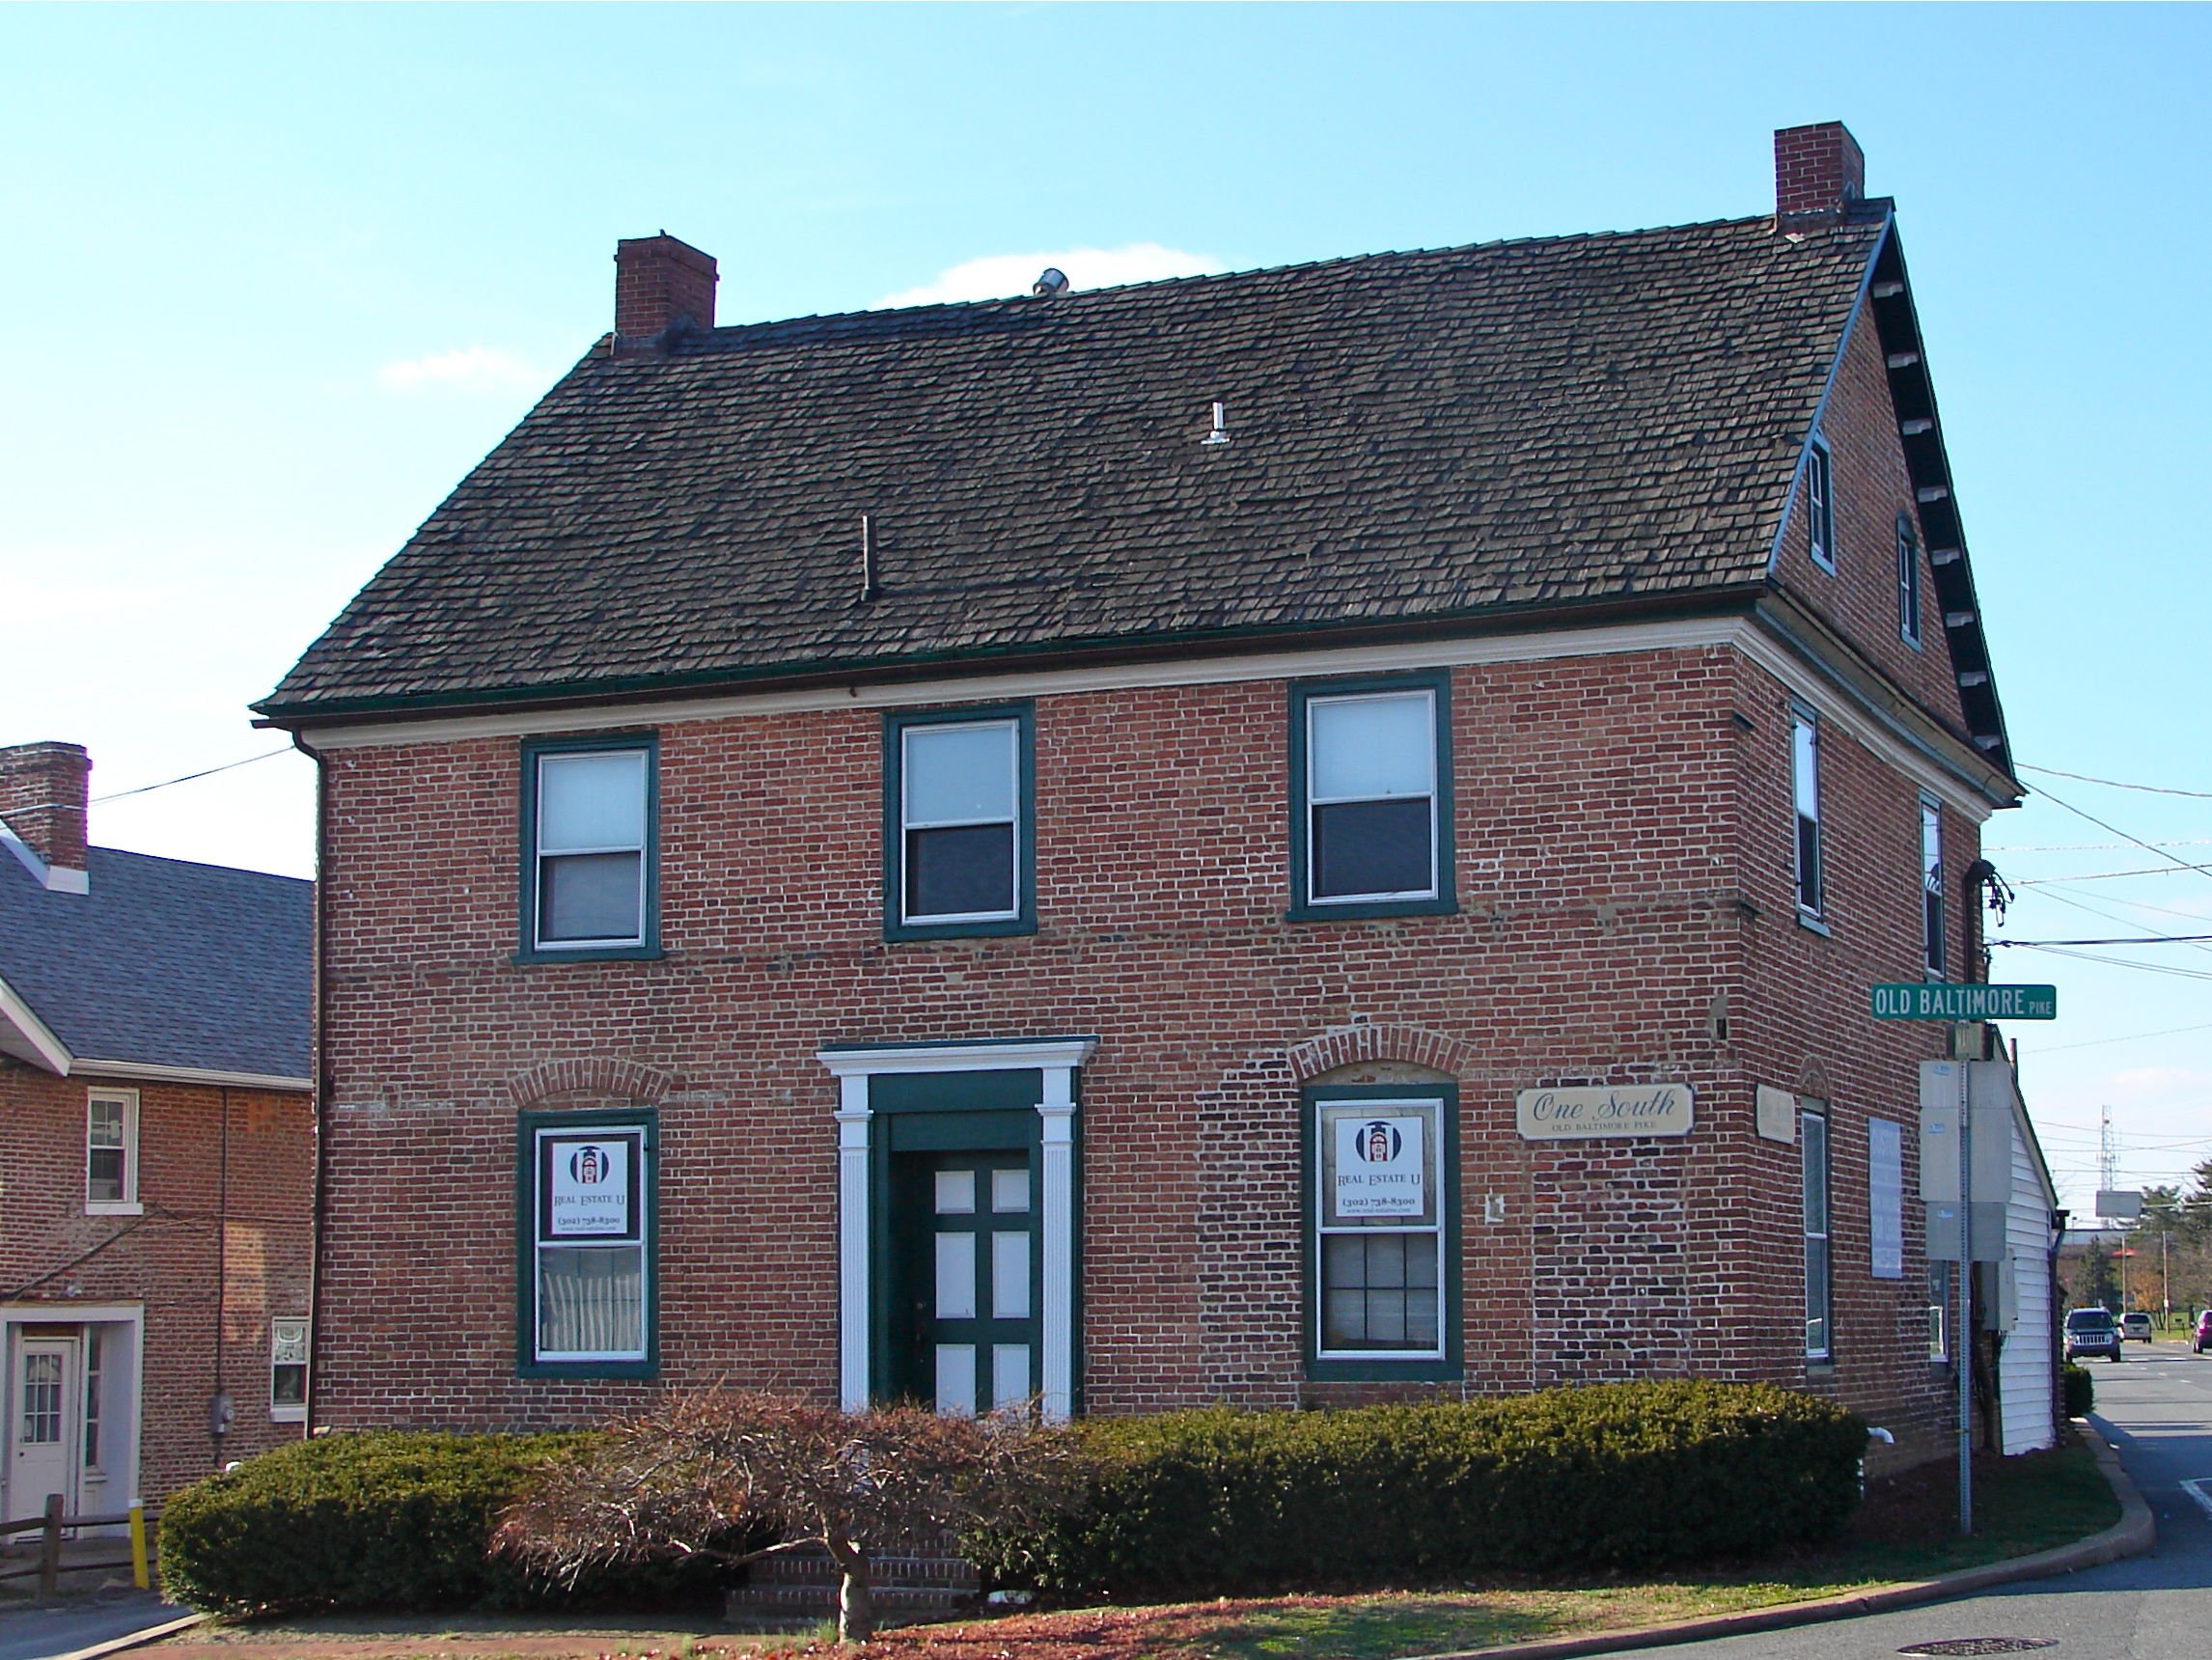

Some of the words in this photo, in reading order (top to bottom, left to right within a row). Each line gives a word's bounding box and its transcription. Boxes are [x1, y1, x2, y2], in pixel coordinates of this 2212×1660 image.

[1875, 988, 1911, 1014] OLD
[1920, 988, 2025, 1014] BALTIMORE
[2029, 1001, 2053, 1014] PIKE
[1533, 1093, 1584, 1121] One
[1591, 1088, 1675, 1121] South
[1551, 1123, 1571, 1132] OLD
[1576, 1121, 1629, 1131] BALTIMORE
[1338, 1175, 1364, 1186] REAL
[1369, 1174, 1406, 1186] ESTATE
[554, 1196, 575, 1206] REAL
[581, 1195, 612, 1206] ESTATE
[1342, 1198, 1369, 1207] (302)
